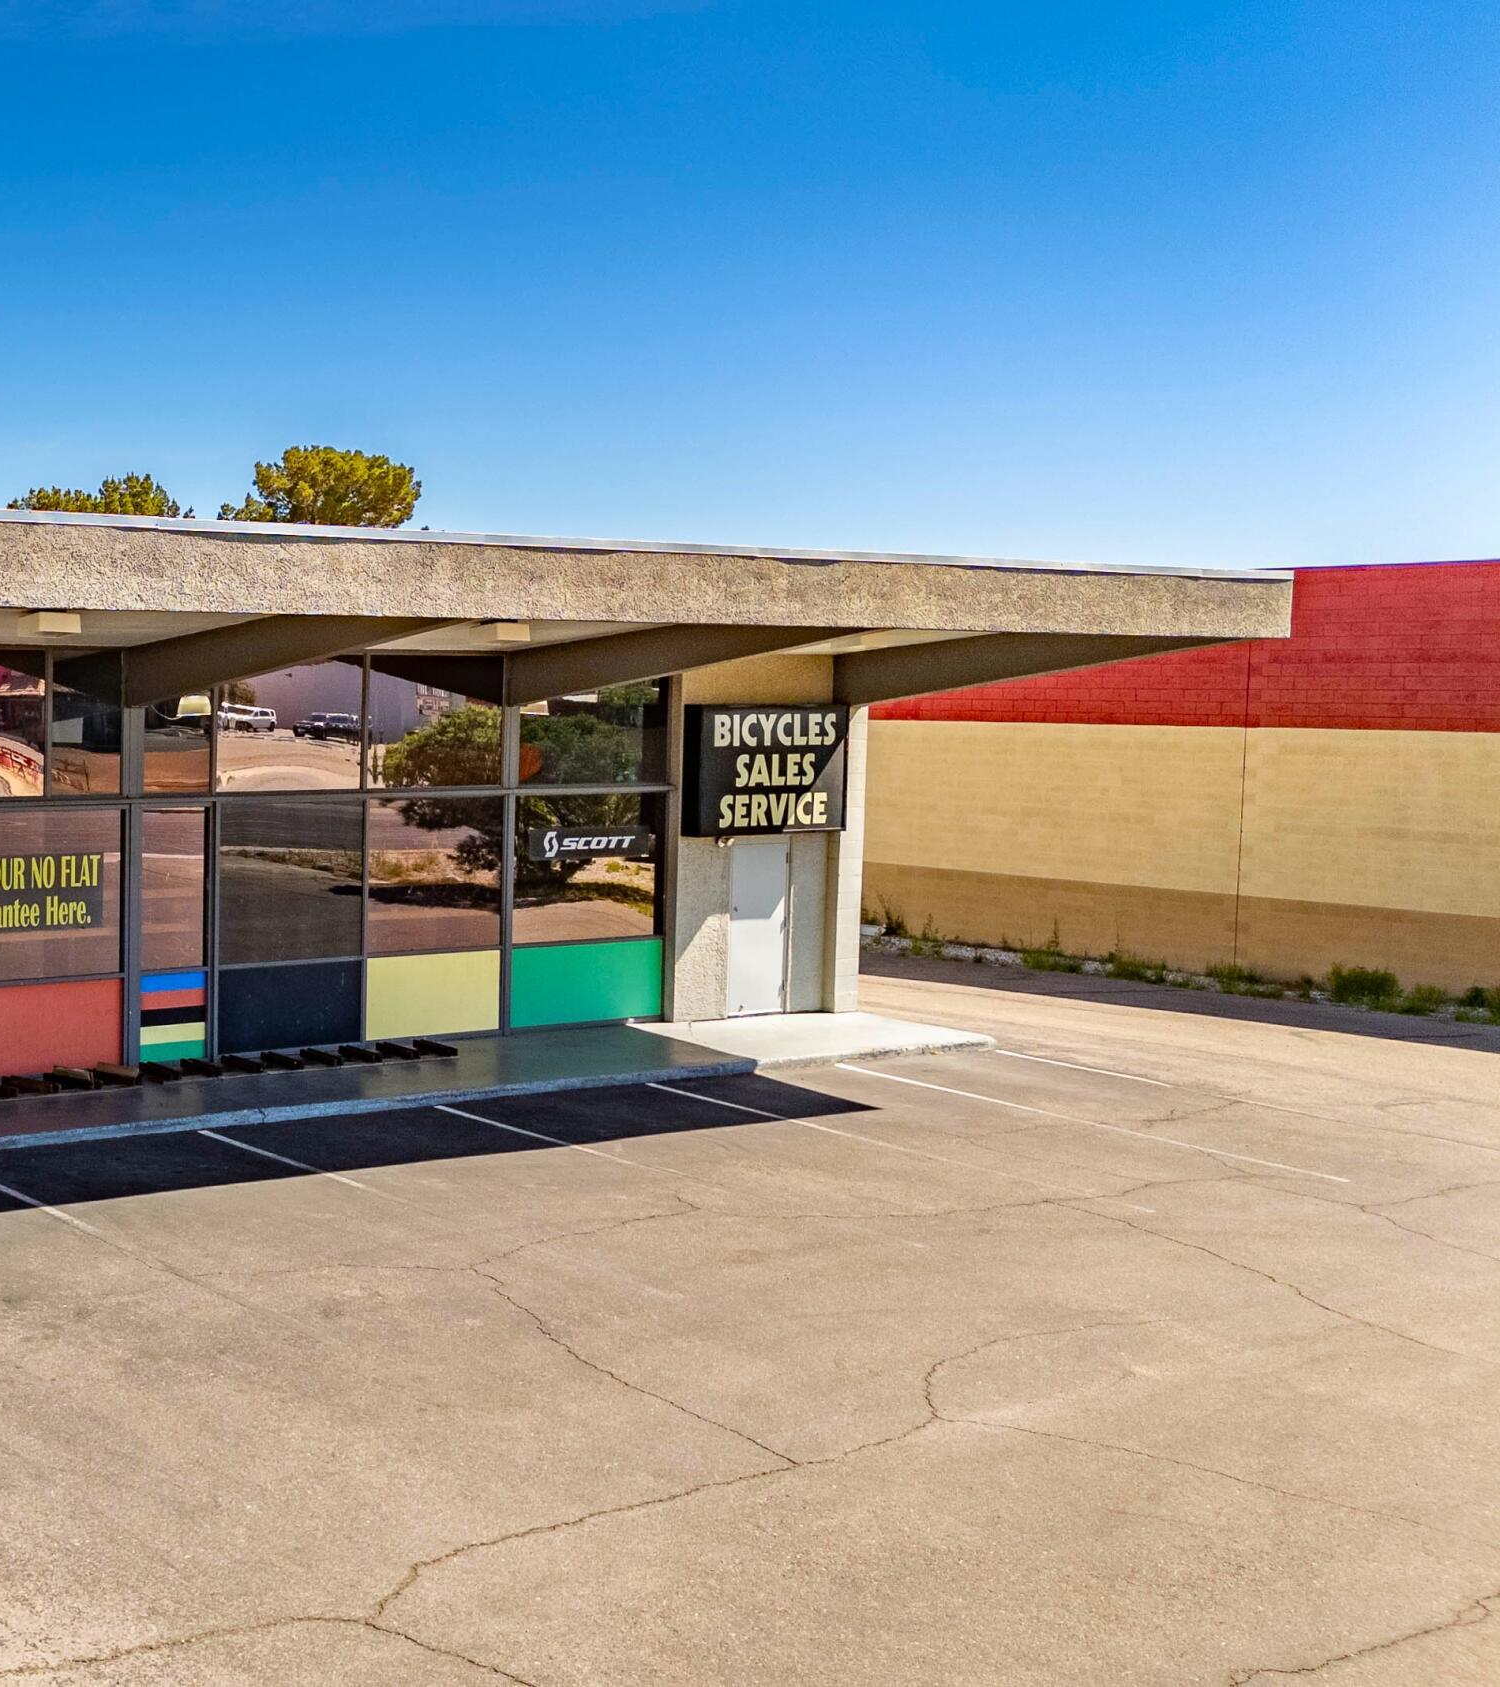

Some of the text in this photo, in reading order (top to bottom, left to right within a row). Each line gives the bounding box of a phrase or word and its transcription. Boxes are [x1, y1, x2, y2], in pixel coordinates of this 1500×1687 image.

[714, 713, 837, 747] BICYCLES
[735, 753, 816, 788] SALES
[719, 792, 828, 828] SERVICE
[560, 836, 636, 850] SCOTT
[31, 856, 55, 888] NO
[61, 855, 101, 888] FLAT
[46, 896, 92, 926] Here.
